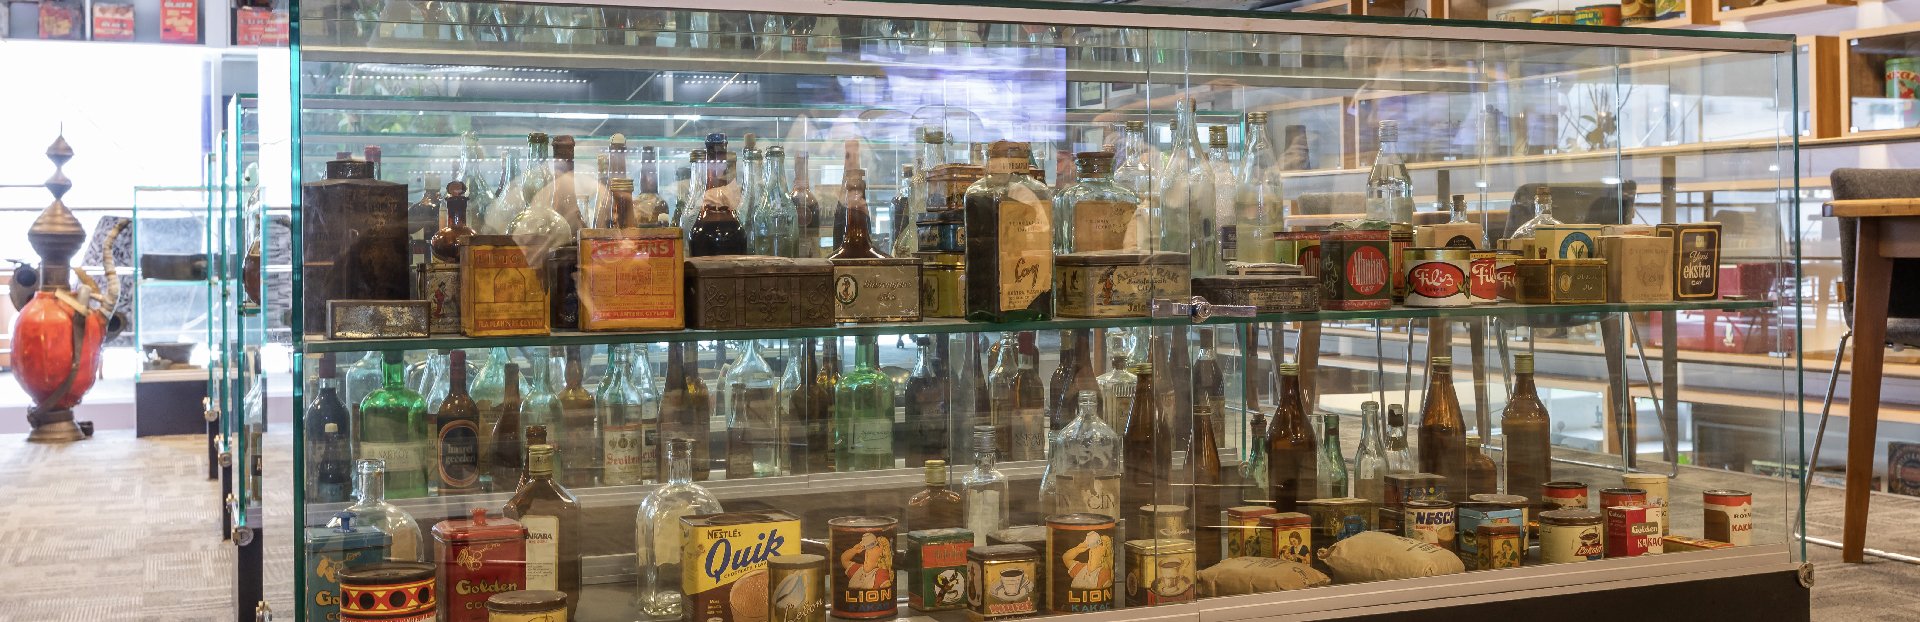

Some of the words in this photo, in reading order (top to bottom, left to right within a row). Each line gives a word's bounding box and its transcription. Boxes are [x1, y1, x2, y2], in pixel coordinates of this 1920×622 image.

[1414, 268, 1454, 287] Filiz
[1683, 261, 1711, 280] ekstra
[1637, 536, 1663, 549] KAKAO
[704, 528, 785, 584] Quik
[456, 578, 518, 595] Golden
[845, 588, 892, 603] LION
[1068, 588, 1113, 603] LION
